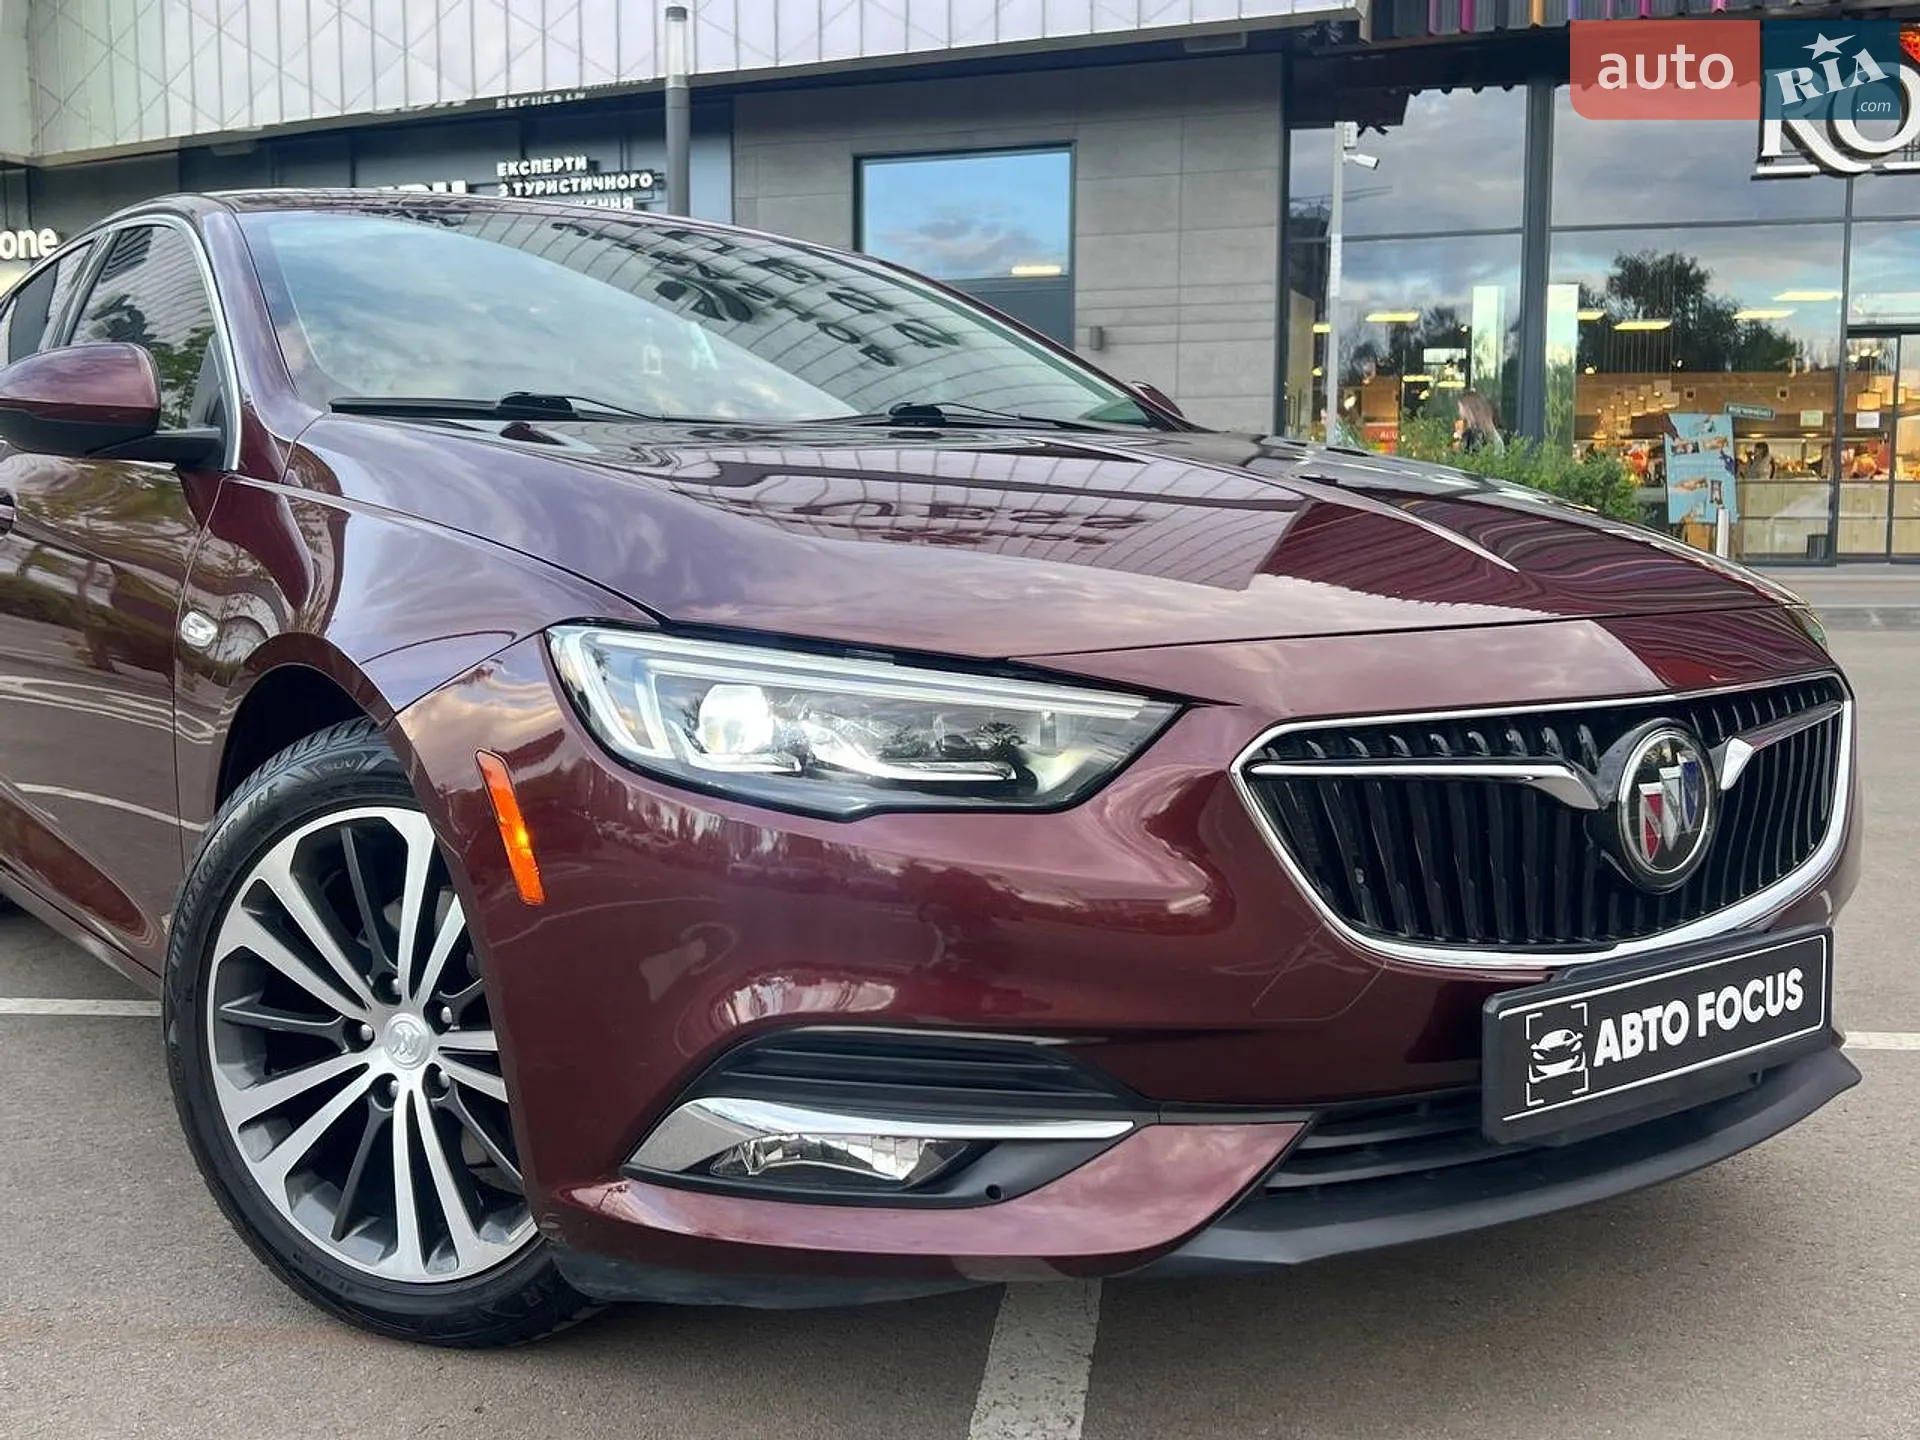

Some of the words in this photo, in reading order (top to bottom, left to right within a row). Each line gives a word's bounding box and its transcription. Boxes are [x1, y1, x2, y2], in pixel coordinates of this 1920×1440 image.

[497, 156, 588, 177] ЕКСПЕРТИ
[513, 172, 654, 197] ТУРИСТИЧНОГО
[1698, 967, 1804, 1037] FOCUS
